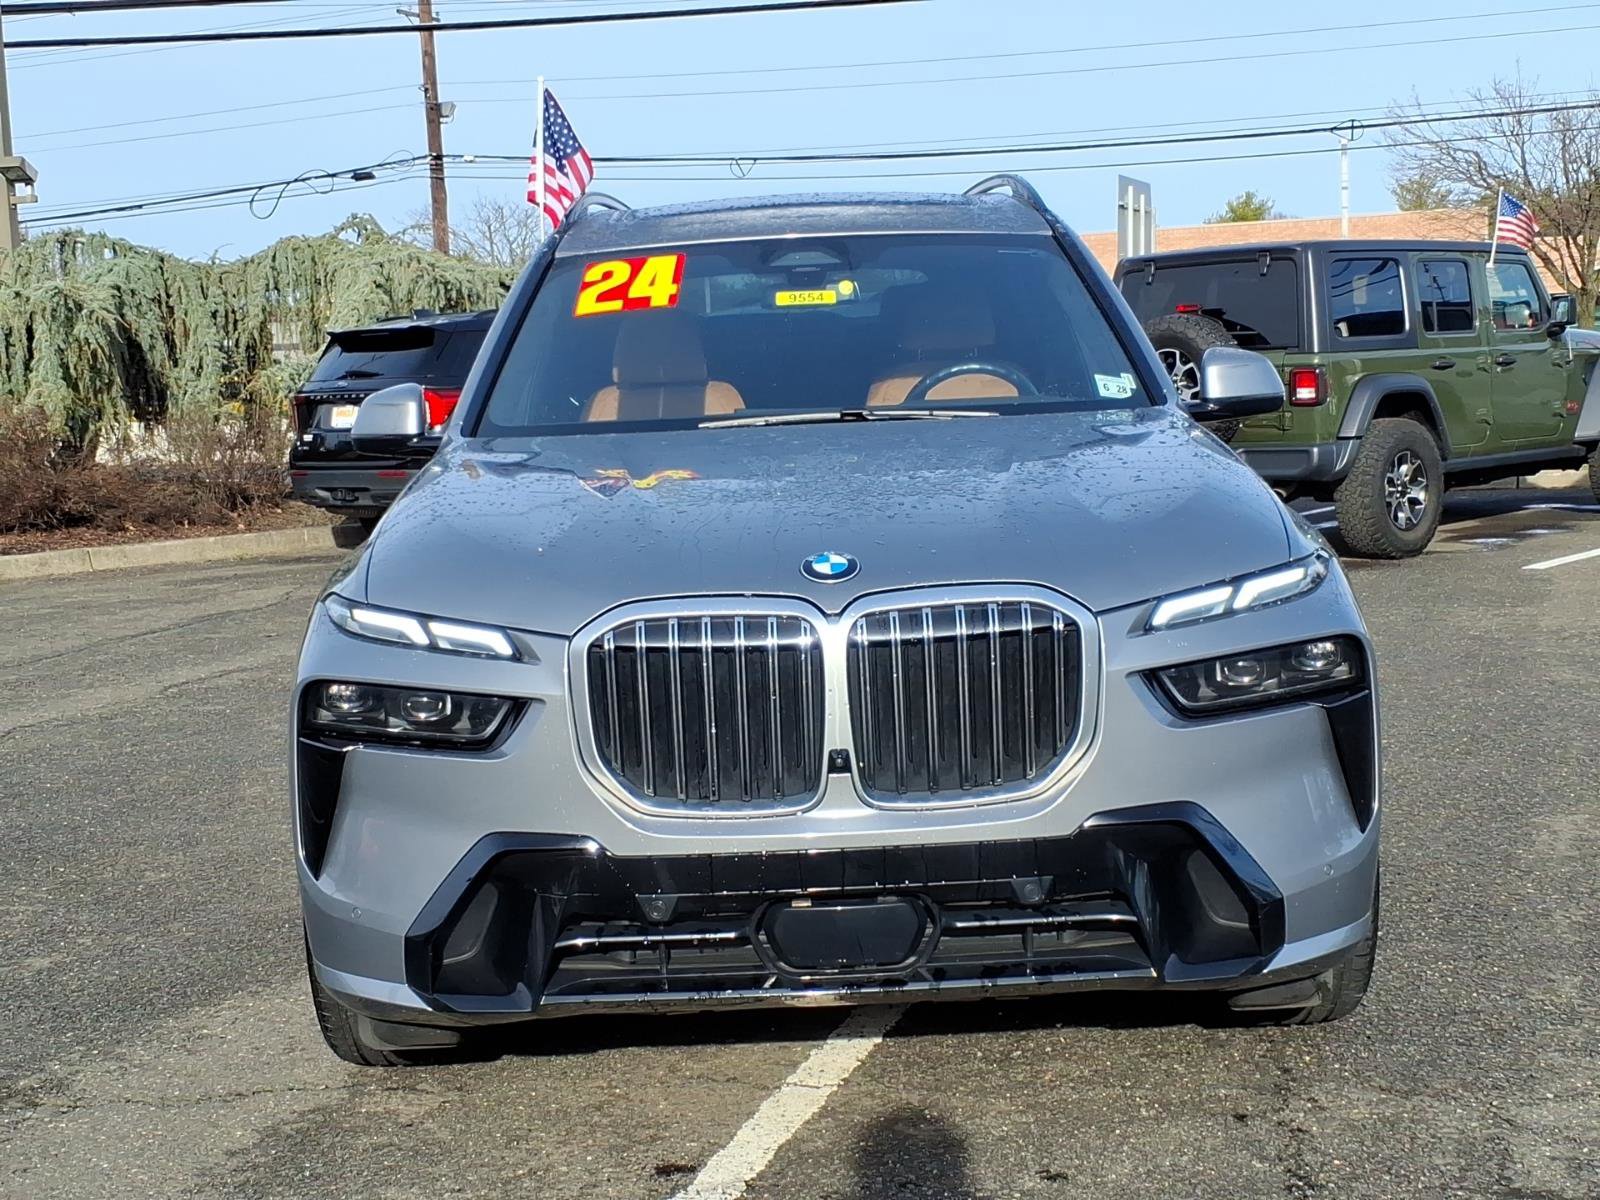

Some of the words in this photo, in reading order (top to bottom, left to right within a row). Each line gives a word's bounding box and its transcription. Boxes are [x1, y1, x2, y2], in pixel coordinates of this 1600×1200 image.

[574, 254, 679, 317] 24
[788, 292, 824, 303] 9554
[1103, 383, 1110, 392] 6
[1115, 384, 1128, 394] 28
